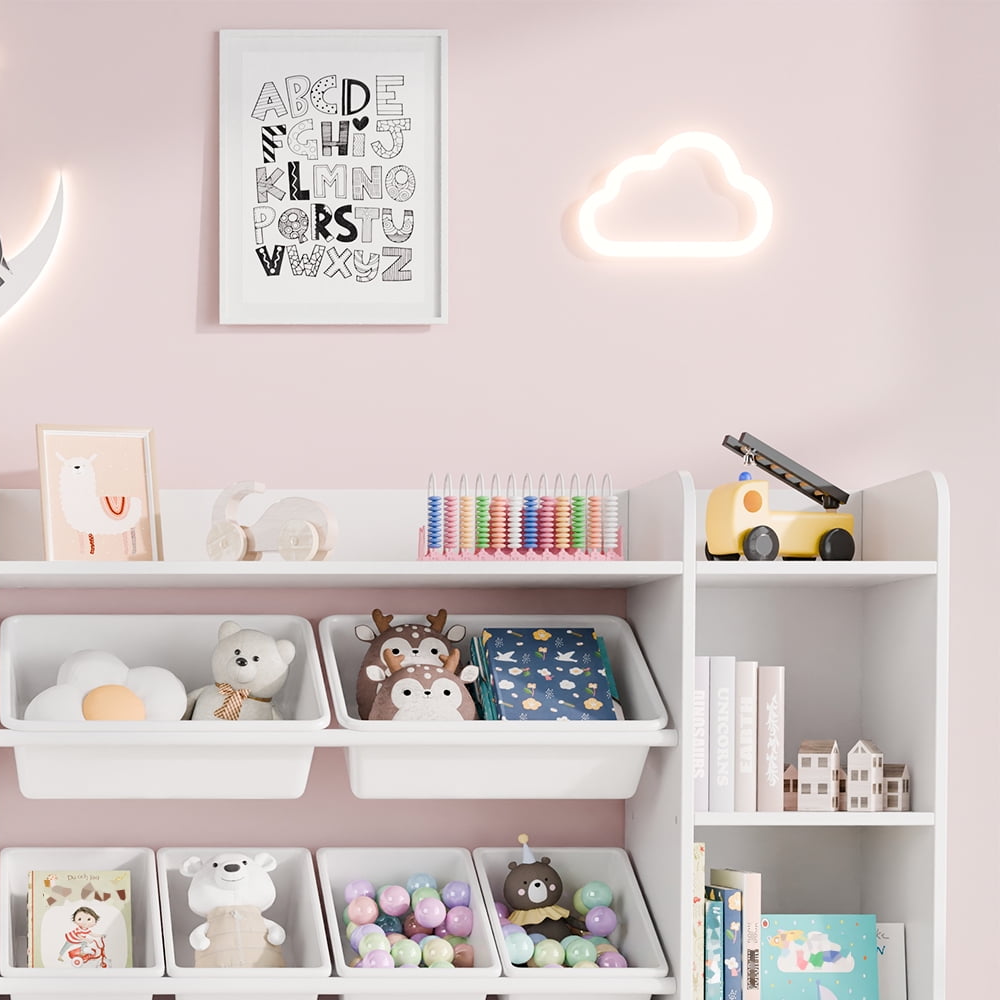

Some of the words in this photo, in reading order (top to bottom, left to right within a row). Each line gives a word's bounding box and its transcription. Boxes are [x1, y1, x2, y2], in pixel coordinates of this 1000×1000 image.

[251, 75, 404, 121] ABCDE
[256, 161, 416, 203] KLMNO
[253, 204, 414, 244] PQRSTU
[717, 687, 730, 787] UNICORNS
[740, 696, 753, 774] EARTH
